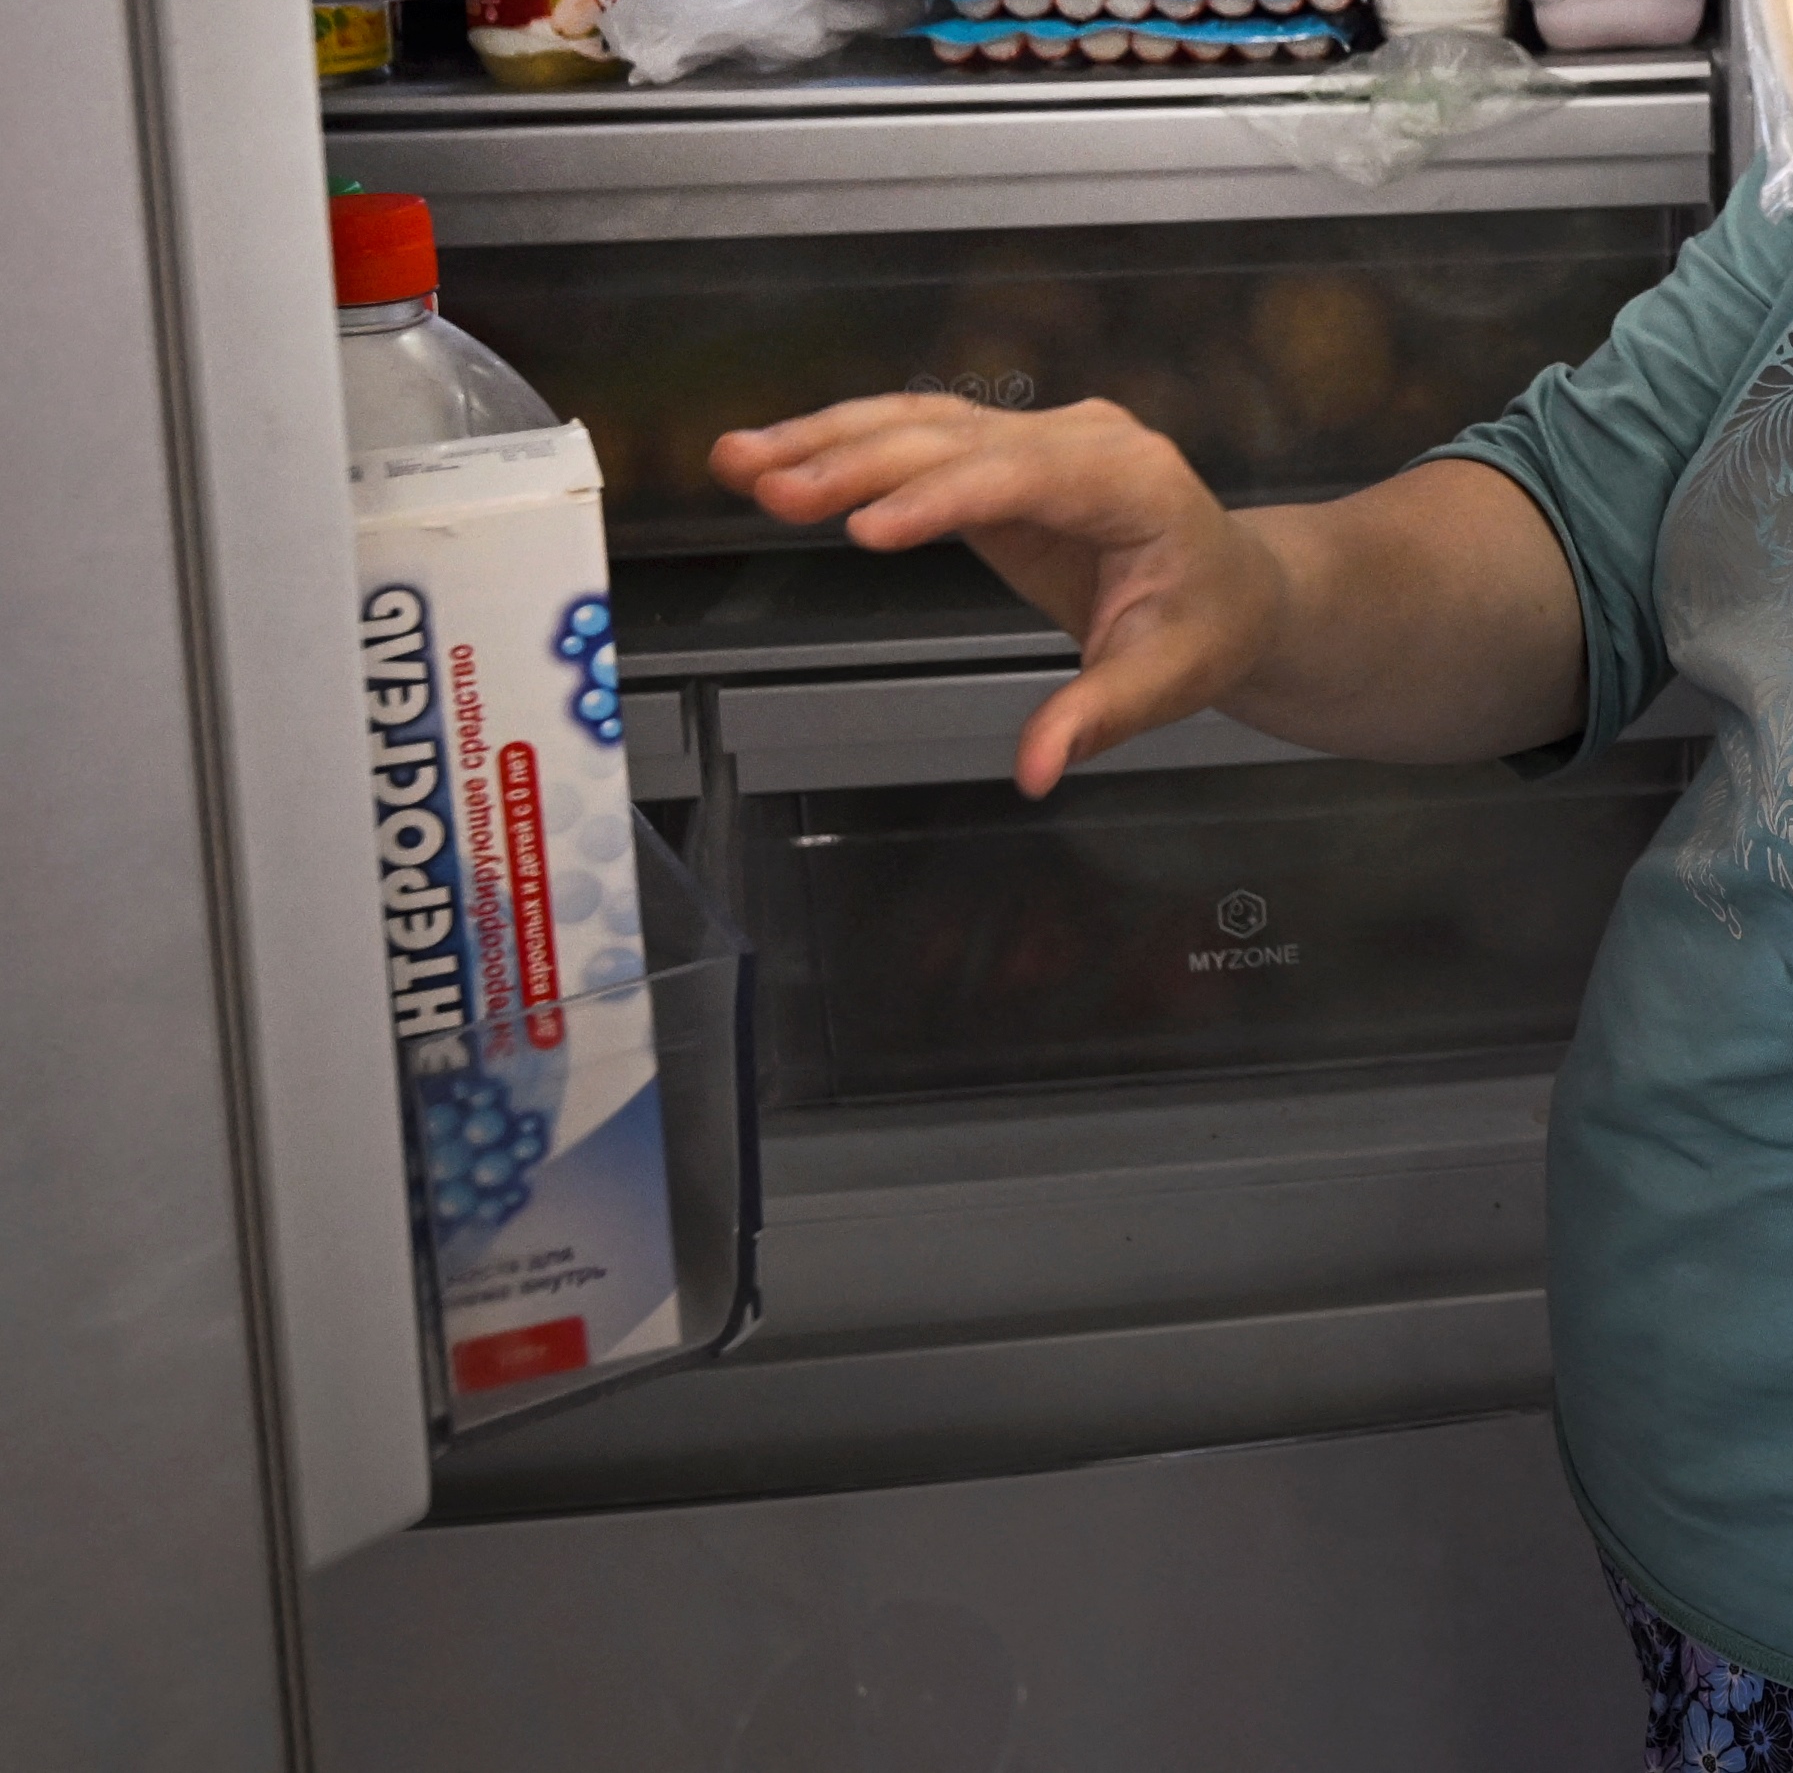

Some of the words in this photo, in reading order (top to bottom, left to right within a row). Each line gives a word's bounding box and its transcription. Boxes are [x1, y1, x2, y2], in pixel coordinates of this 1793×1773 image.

[449, 643, 491, 770] средство
[506, 748, 530, 783] лет
[505, 788, 531, 802] 0
[512, 803, 533, 817] с
[509, 819, 542, 876] детей
[520, 881, 540, 895] и
[522, 897, 554, 996] взрослых
[1188, 943, 1300, 972] MYZONE
